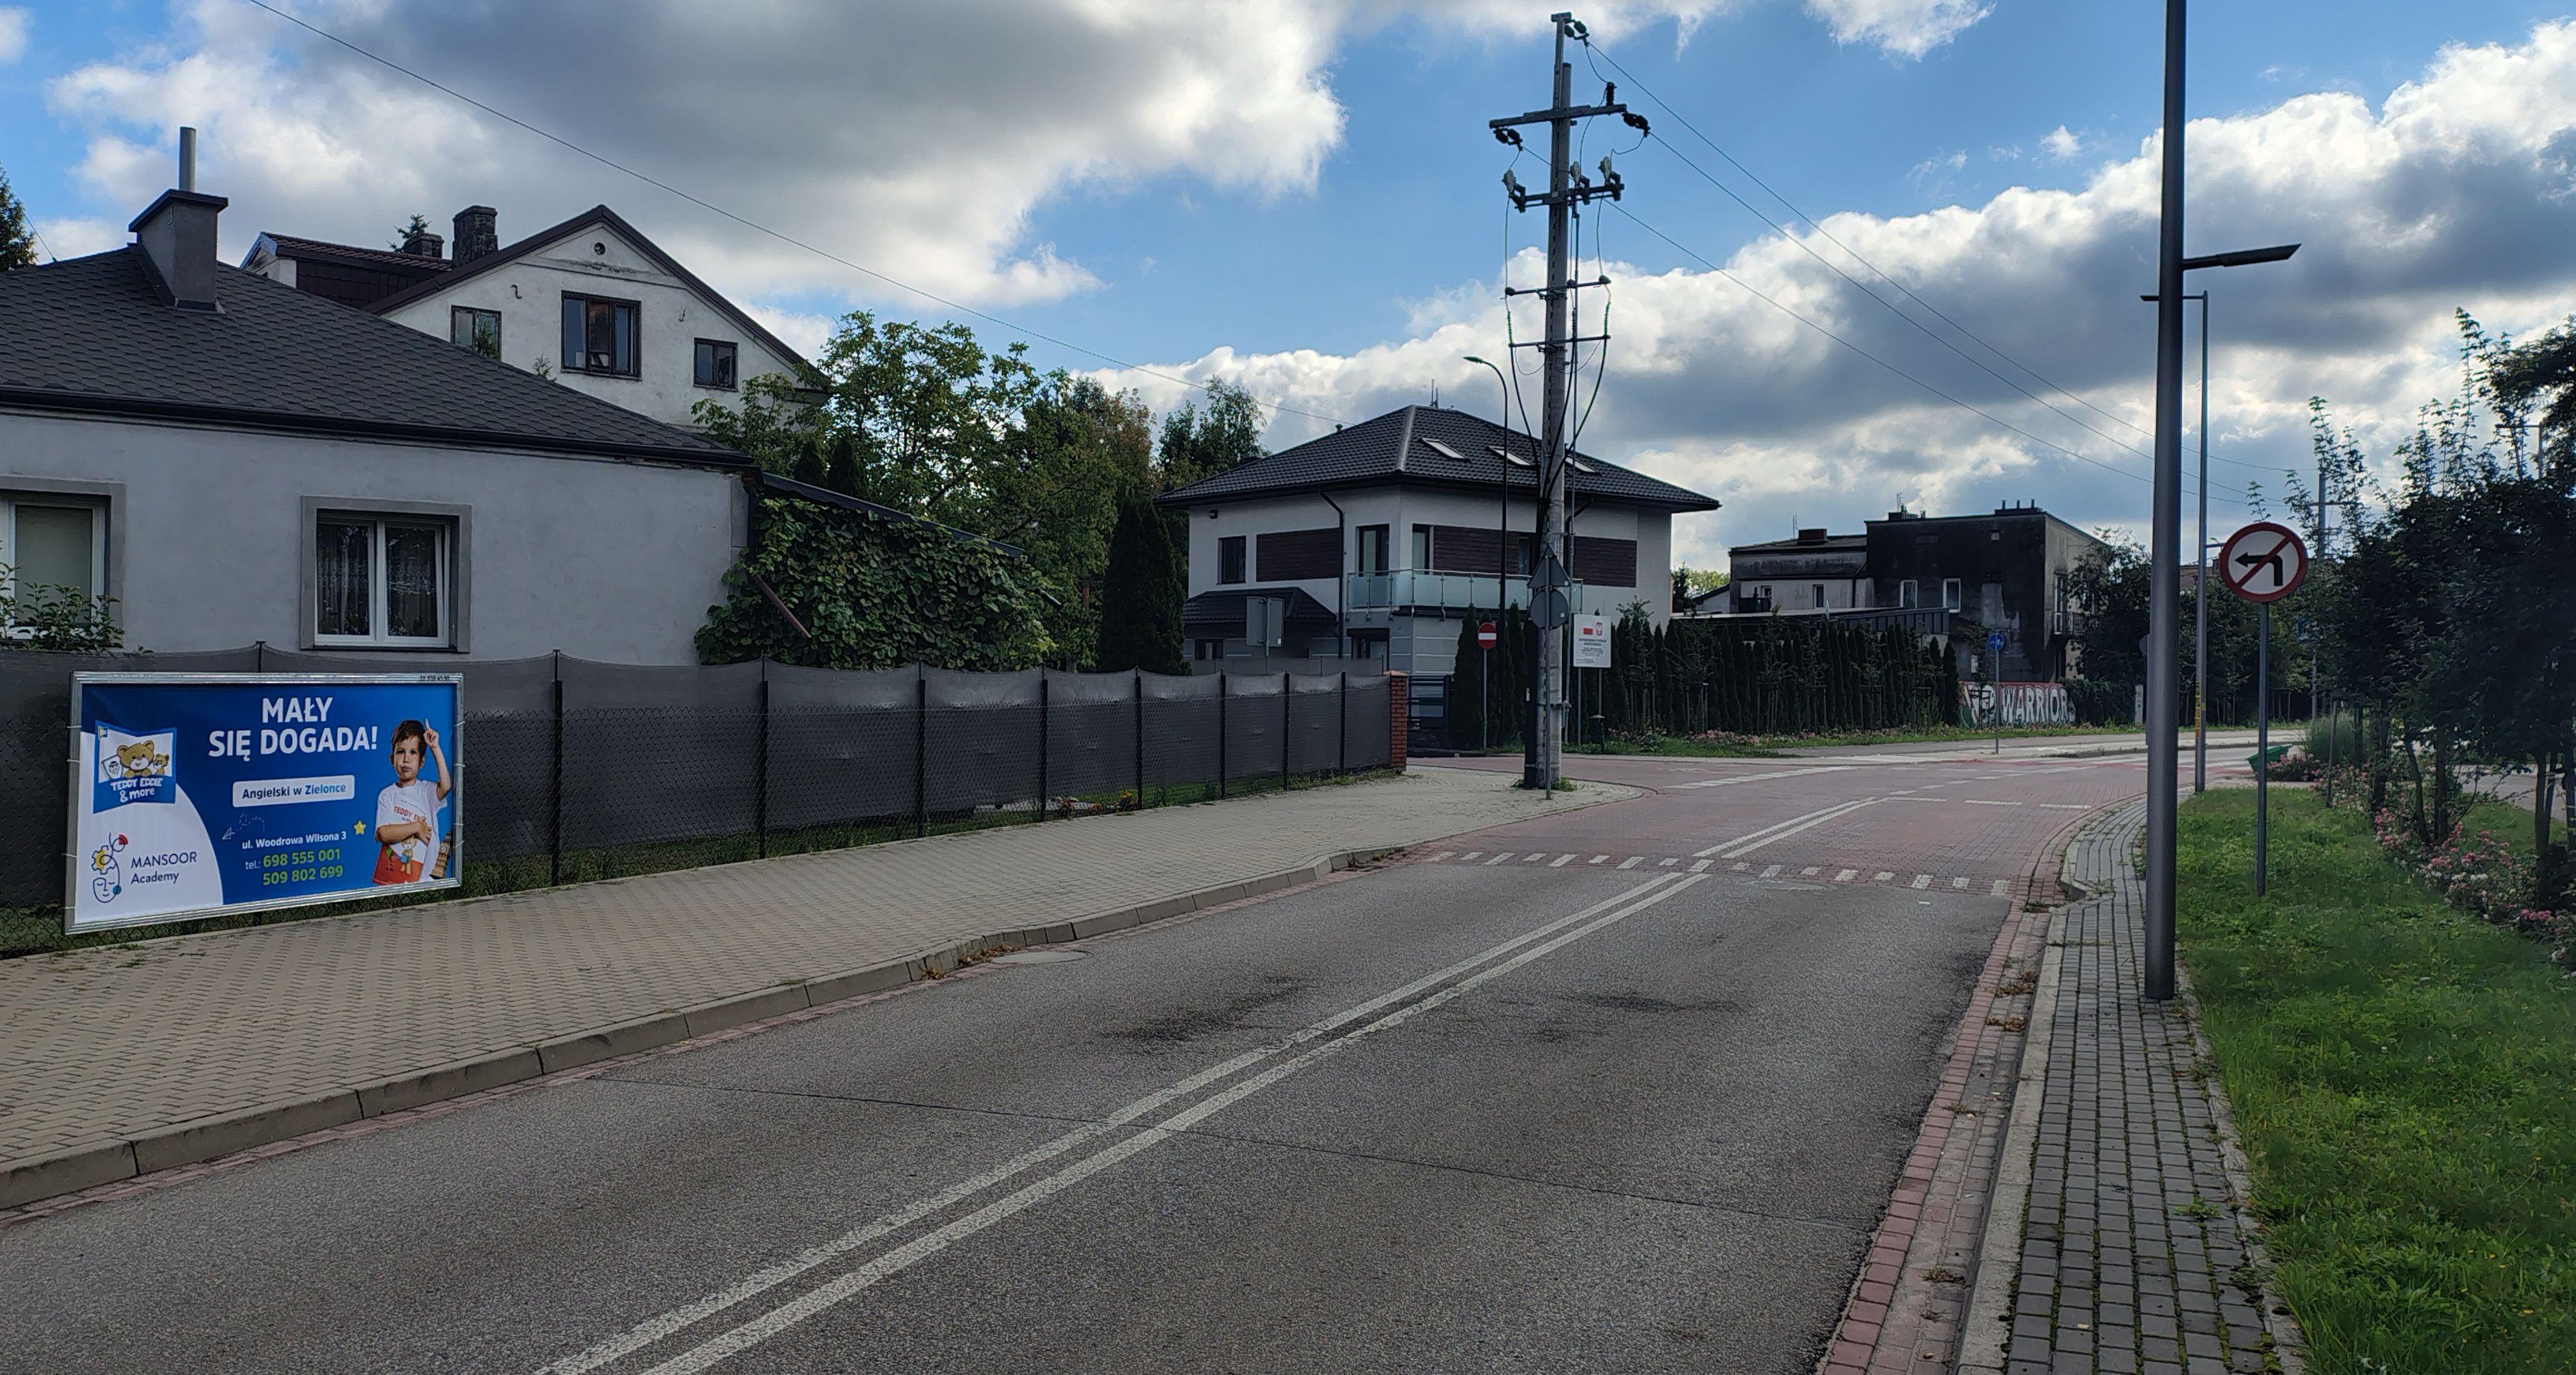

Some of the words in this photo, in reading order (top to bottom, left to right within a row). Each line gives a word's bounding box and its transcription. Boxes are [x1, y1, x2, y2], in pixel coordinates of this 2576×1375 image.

[262, 697, 333, 723] MAŁY
[208, 730, 251, 762] SIĘ
[260, 726, 378, 755] DOGADA!
[110, 779, 138, 791] TEDDY
[140, 777, 164, 787] EDDIE
[242, 786, 290, 799] Angielski
[305, 783, 346, 795] Zielonce
[119, 790, 129, 803] &
[129, 788, 156, 799] more
[393, 805, 413, 817] TEDDY
[242, 841, 253, 849] ul.
[256, 836, 303, 848] Woodrowa
[305, 833, 340, 843] Wilsona
[341, 831, 347, 839] 3
[131, 851, 197, 869] MANSOOR
[245, 859, 261, 870] tel.:
[263, 854, 288, 868] 698
[292, 851, 314, 865] 555
[318, 849, 340, 861] 001
[131, 871, 179, 885] Academy
[263, 871, 288, 886] 509
[292, 868, 316, 882] 802
[320, 865, 343, 878] 699
